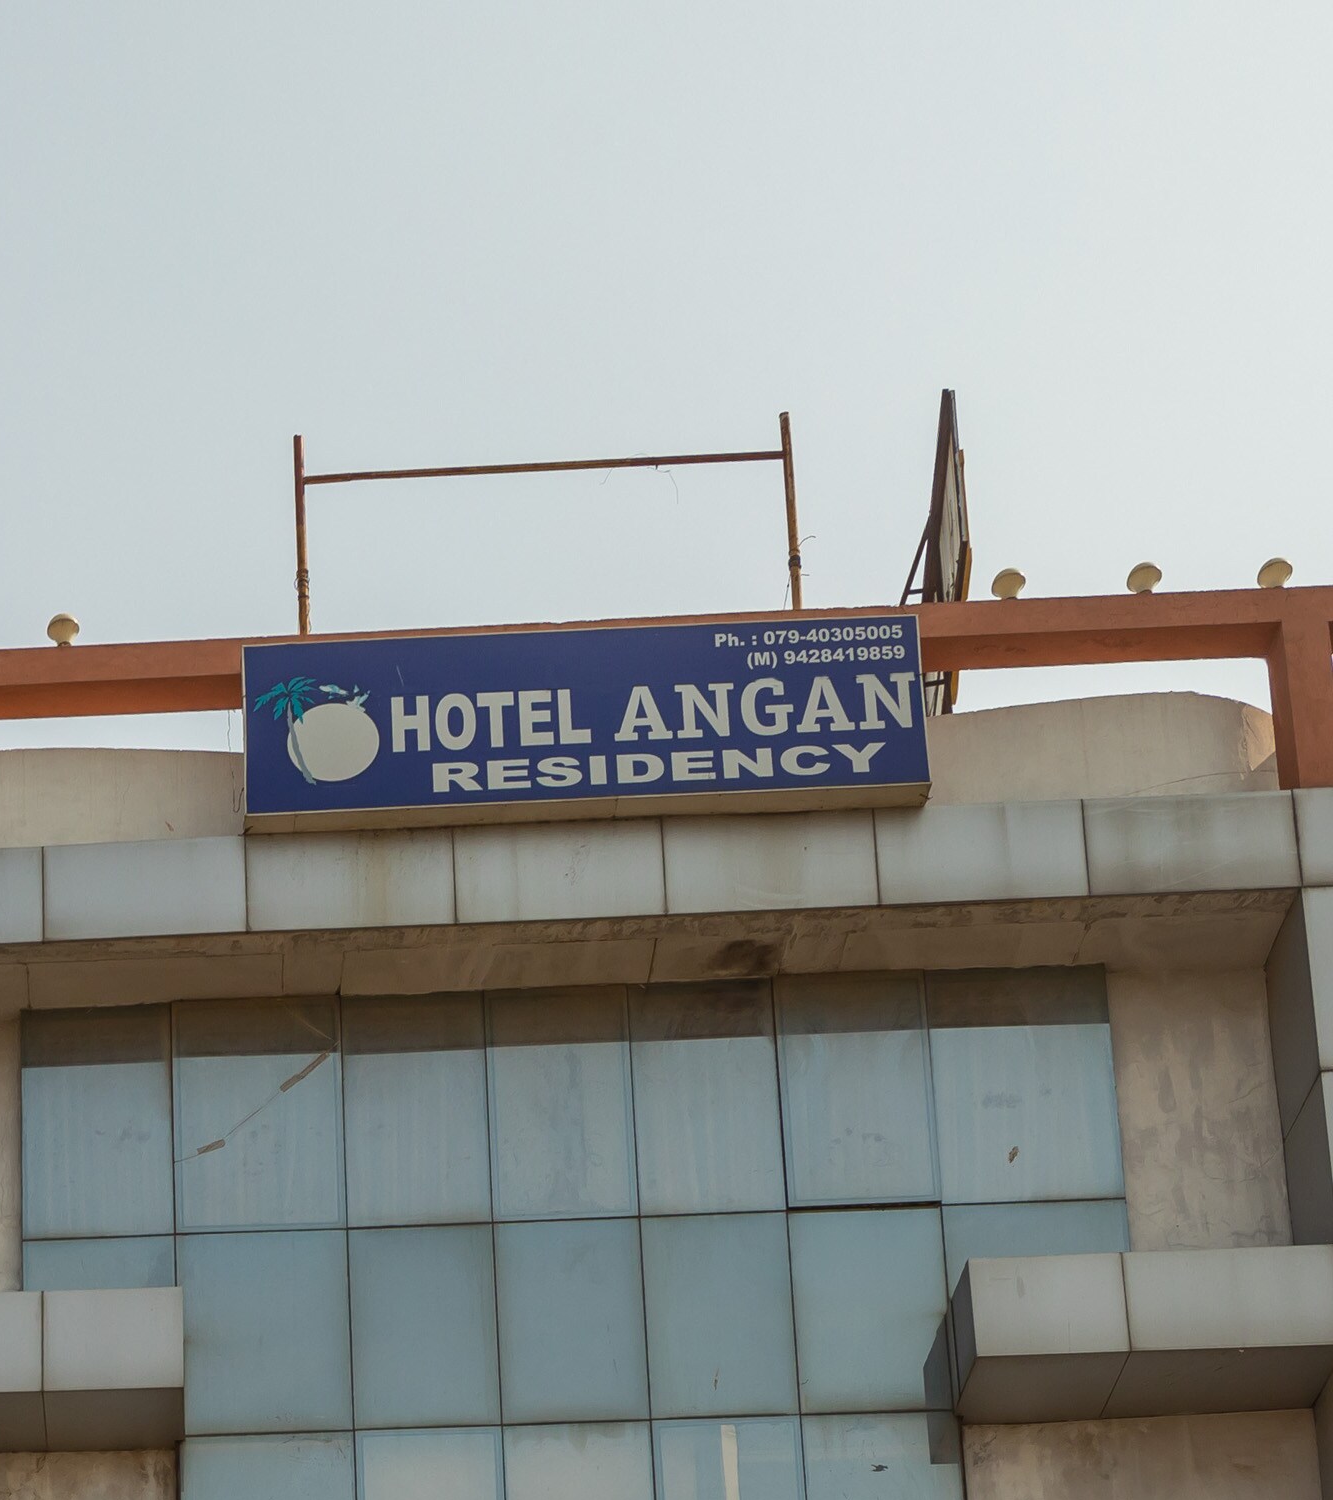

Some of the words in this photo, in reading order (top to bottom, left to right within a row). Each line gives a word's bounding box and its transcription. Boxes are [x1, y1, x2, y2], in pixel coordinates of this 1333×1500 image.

[763, 623, 904, 647] 079-40305005
[746, 650, 778, 670] (M)
[784, 643, 906, 666] 9428419859
[390, 689, 592, 752] HOTEL
[614, 672, 916, 742] ANGAN
[432, 741, 887, 794] RESIDENCY
